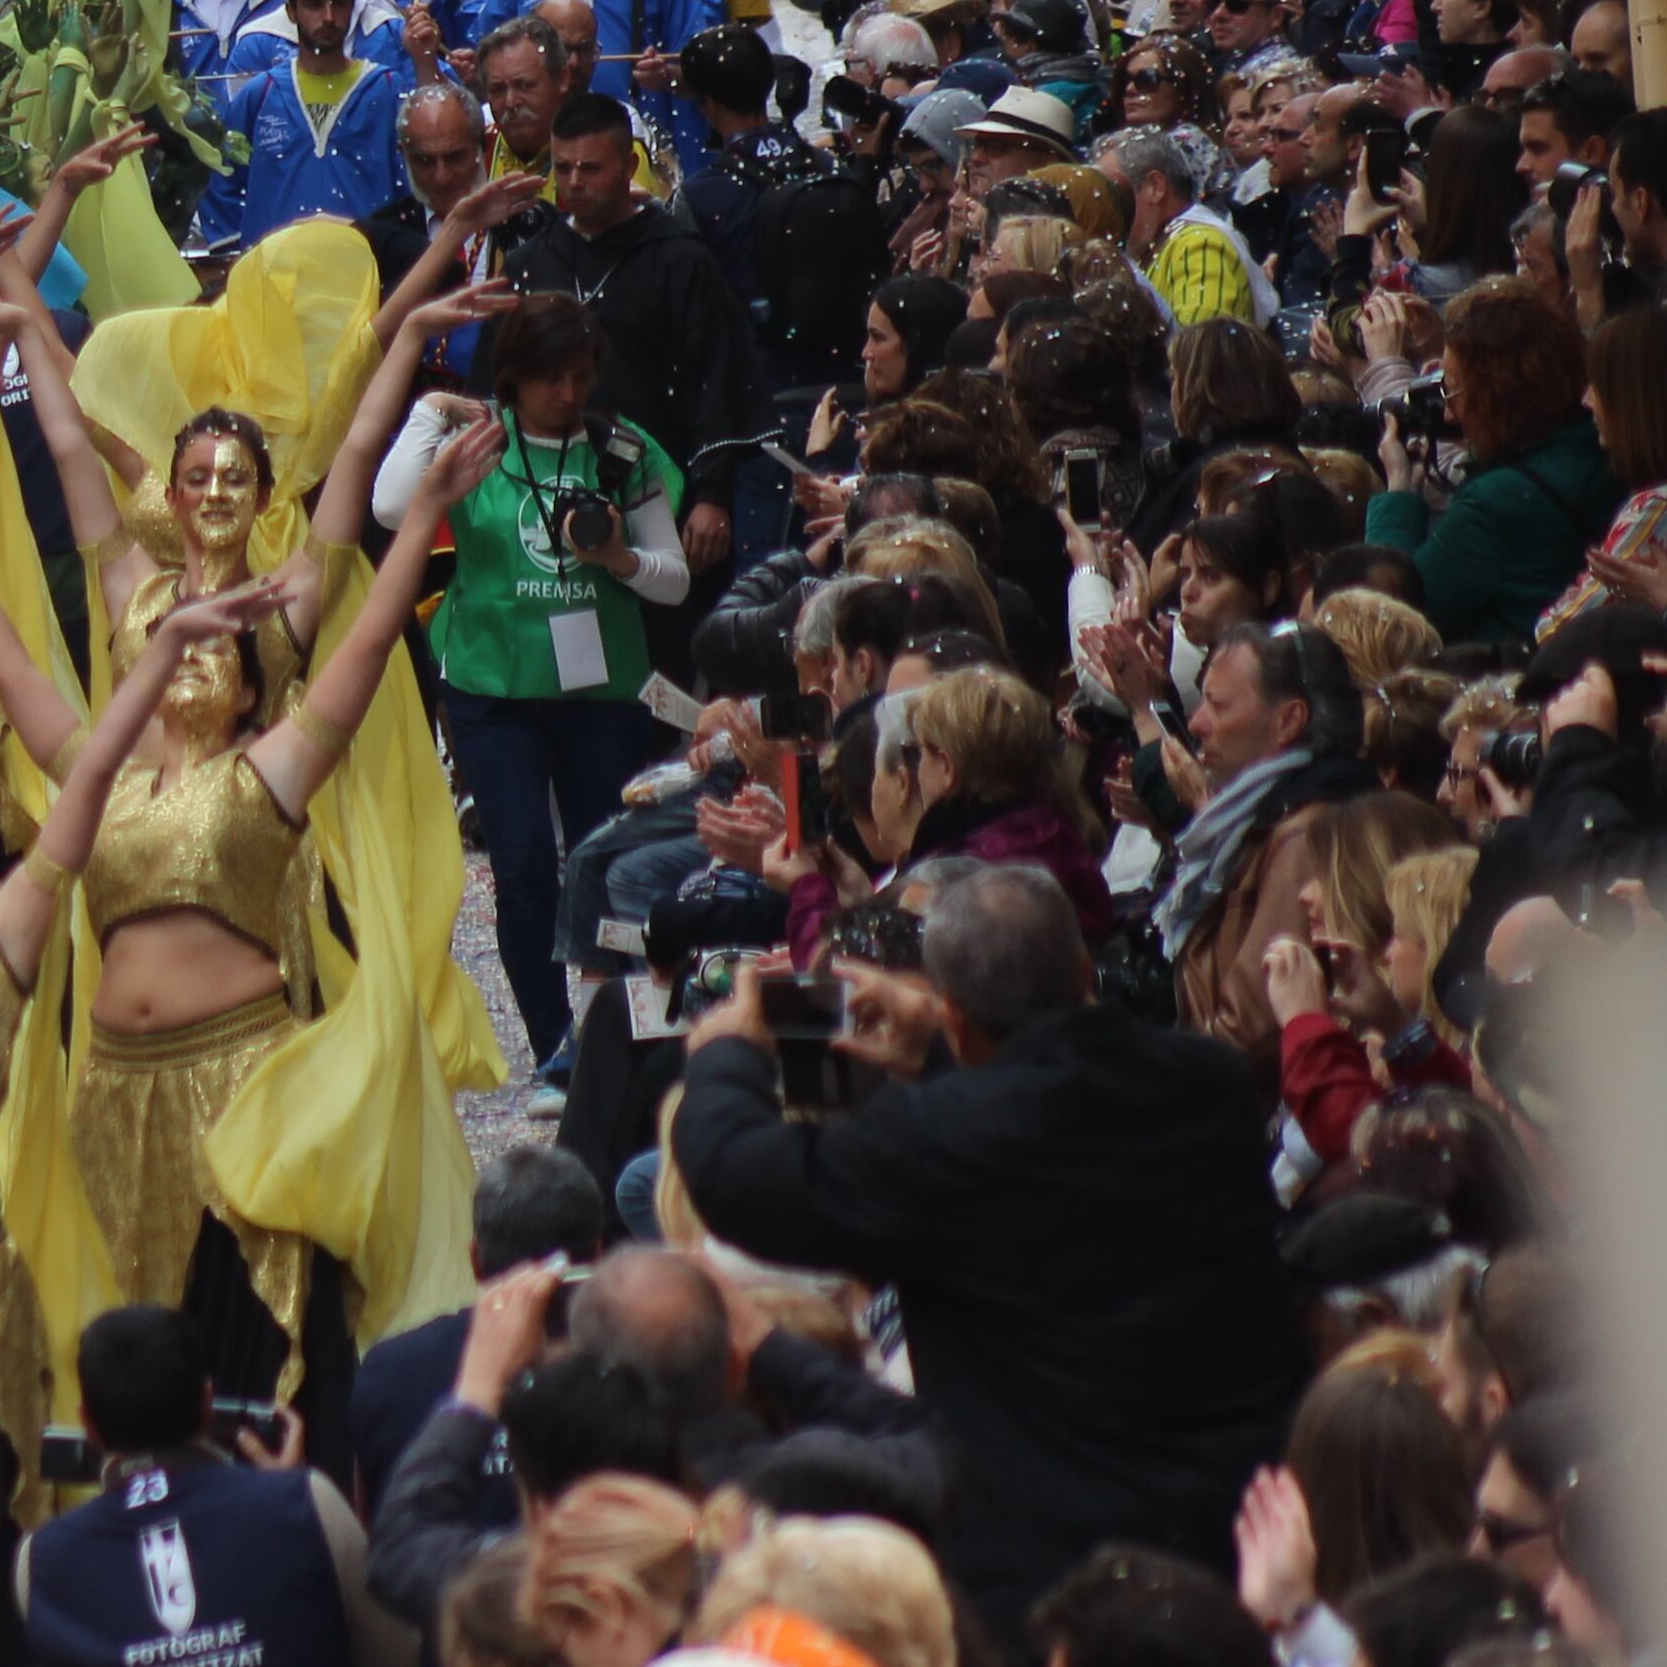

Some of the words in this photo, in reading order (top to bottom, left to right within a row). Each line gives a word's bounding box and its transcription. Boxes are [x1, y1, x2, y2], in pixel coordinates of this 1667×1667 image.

[756, 137, 782, 157] 49
[516, 579, 597, 599] PREMSA
[125, 1468, 168, 1509] 23
[124, 1619, 246, 1667] FOTOGRAF
